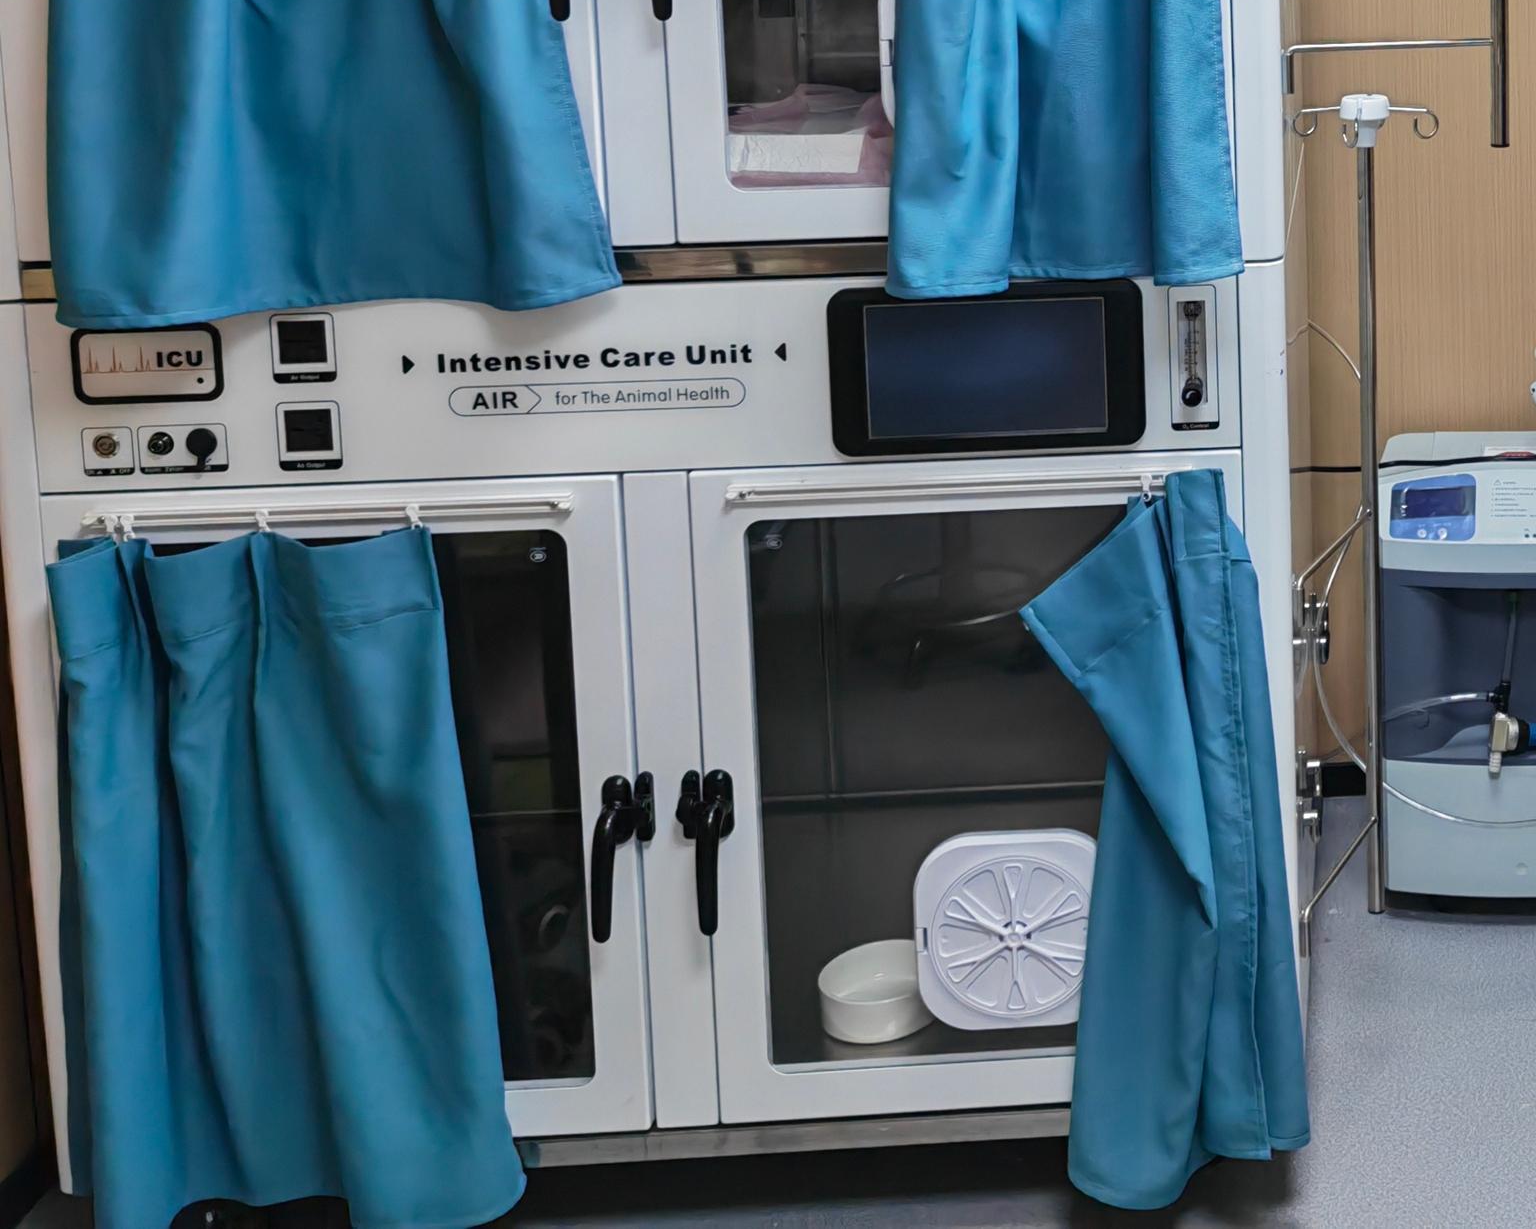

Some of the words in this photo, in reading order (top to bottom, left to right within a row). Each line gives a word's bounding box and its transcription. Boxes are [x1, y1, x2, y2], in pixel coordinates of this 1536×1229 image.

[156, 350, 203, 368] ICU
[437, 349, 590, 373] Intensive
[601, 347, 675, 368] Care
[686, 344, 752, 365] Unit
[472, 391, 519, 410] AIR
[555, 391, 577, 405] for
[581, 390, 610, 404] The
[615, 388, 672, 403] Animal
[676, 387, 730, 402] Health
